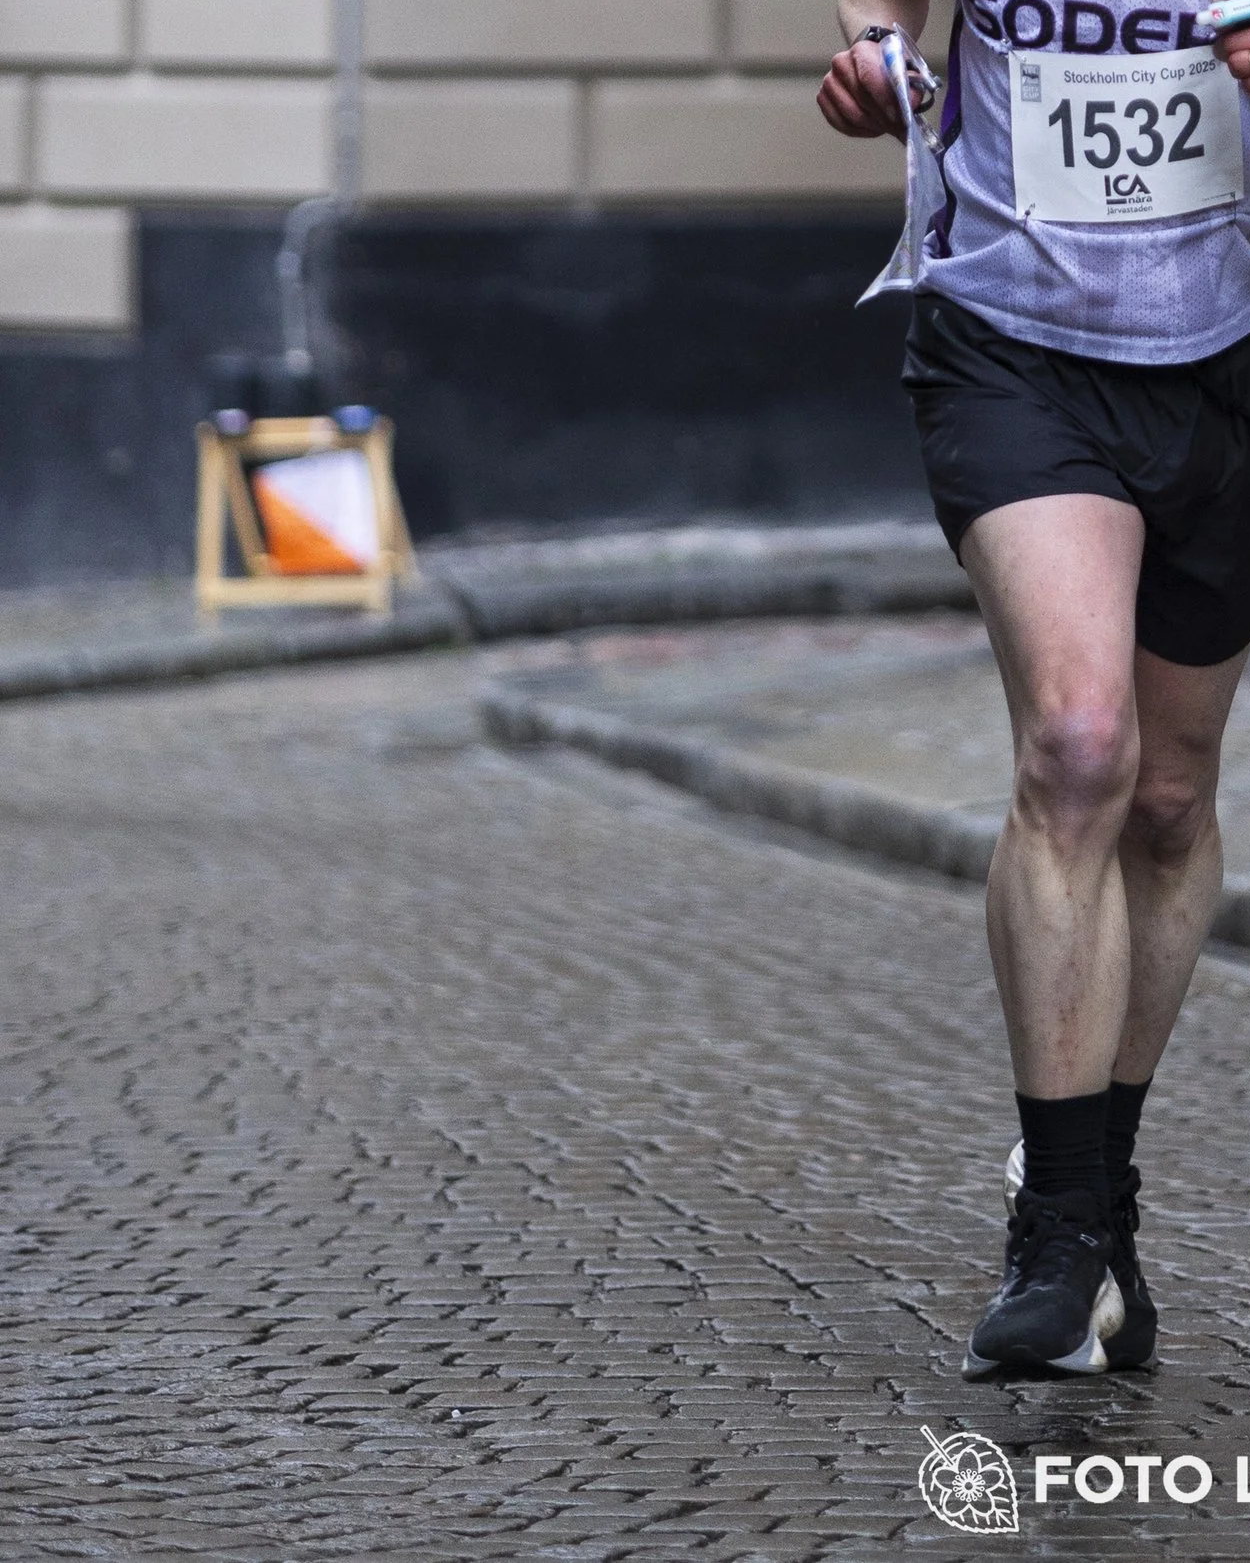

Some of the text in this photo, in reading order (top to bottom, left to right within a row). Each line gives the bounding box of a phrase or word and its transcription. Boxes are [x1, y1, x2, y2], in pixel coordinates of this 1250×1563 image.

[1063, 58, 1217, 84] Stockholm City Cup 2025
[1048, 91, 1205, 169] 1532
[1104, 173, 1151, 196] ICA
[1128, 195, 1153, 204] nära
